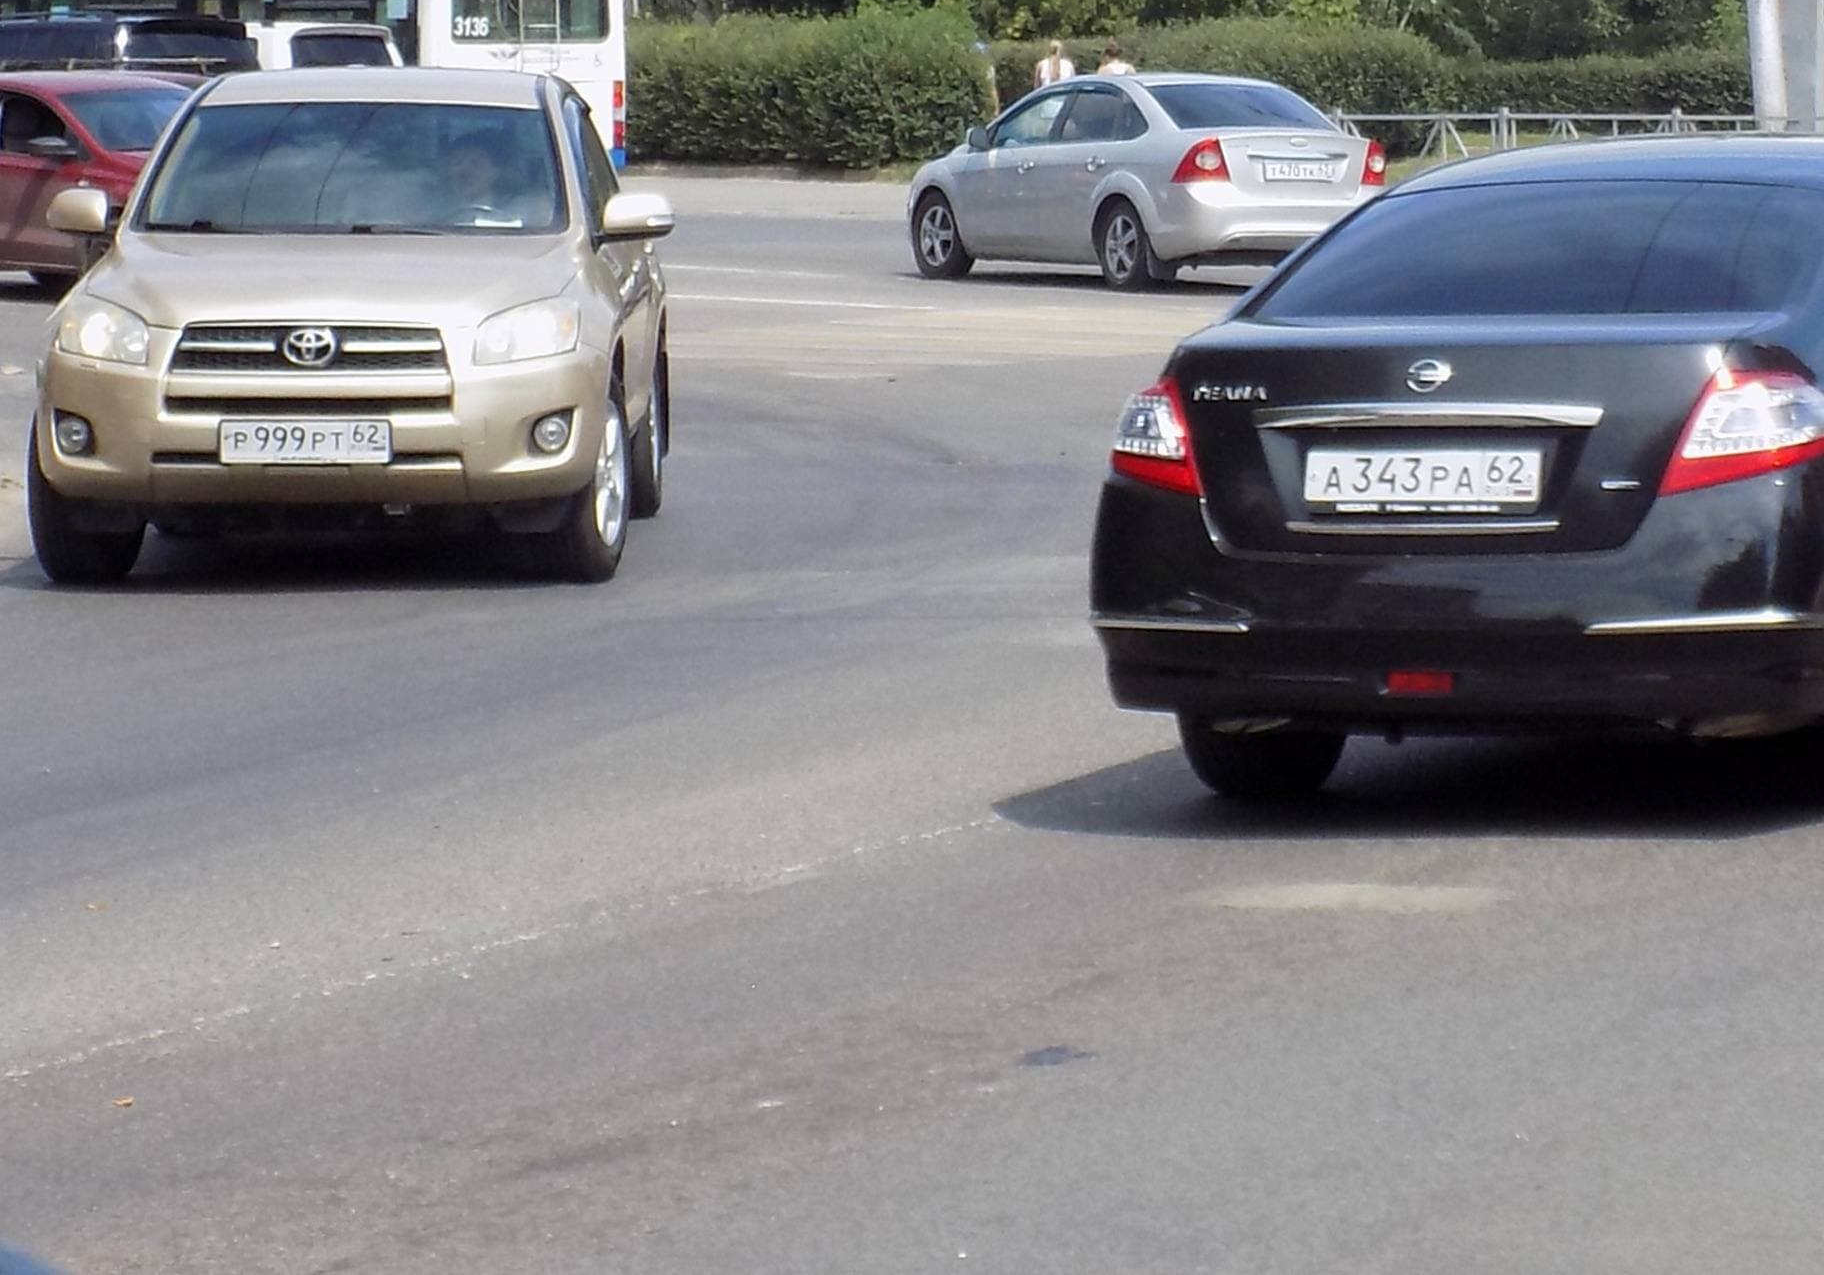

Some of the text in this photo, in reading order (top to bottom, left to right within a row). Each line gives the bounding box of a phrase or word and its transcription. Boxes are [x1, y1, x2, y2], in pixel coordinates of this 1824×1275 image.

[453, 15, 489, 37] 3136
[352, 424, 380, 444] 62
[1323, 456, 1525, 494] А343РА 62
